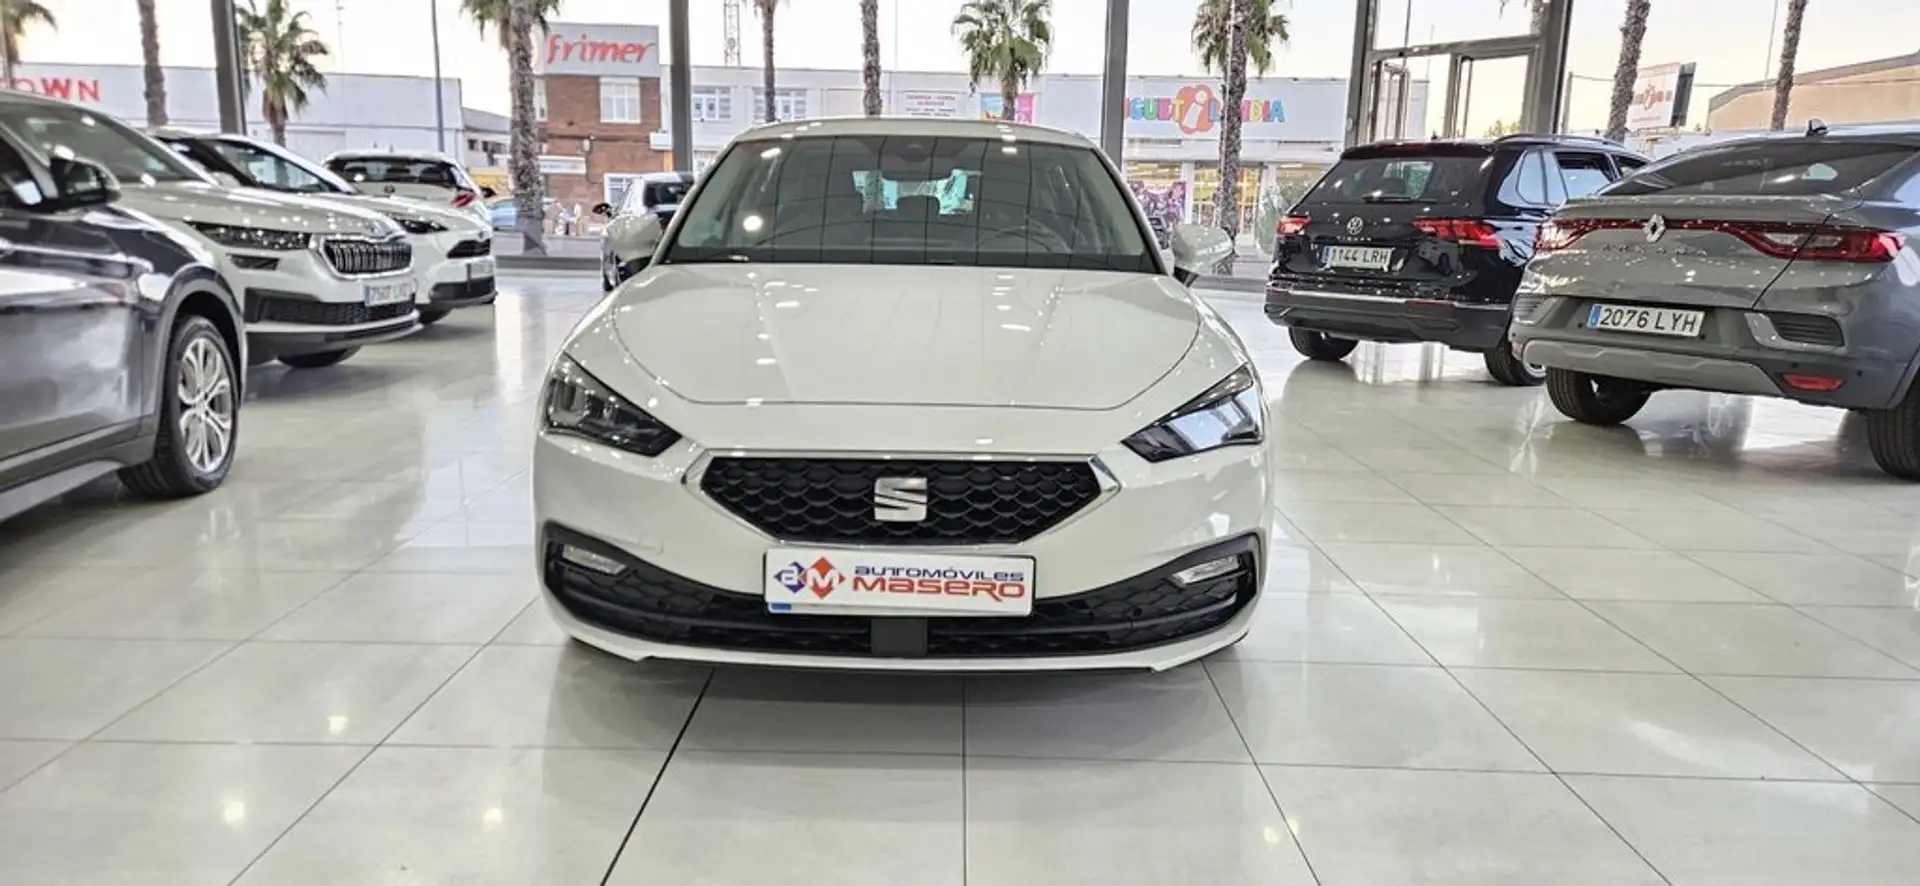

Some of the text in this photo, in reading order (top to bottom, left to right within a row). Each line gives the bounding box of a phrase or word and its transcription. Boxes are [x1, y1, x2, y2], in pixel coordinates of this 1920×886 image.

[547, 33, 656, 64] frimer
[1332, 248, 1357, 261] 1144
[1600, 308, 1696, 332] 2076 LYH
